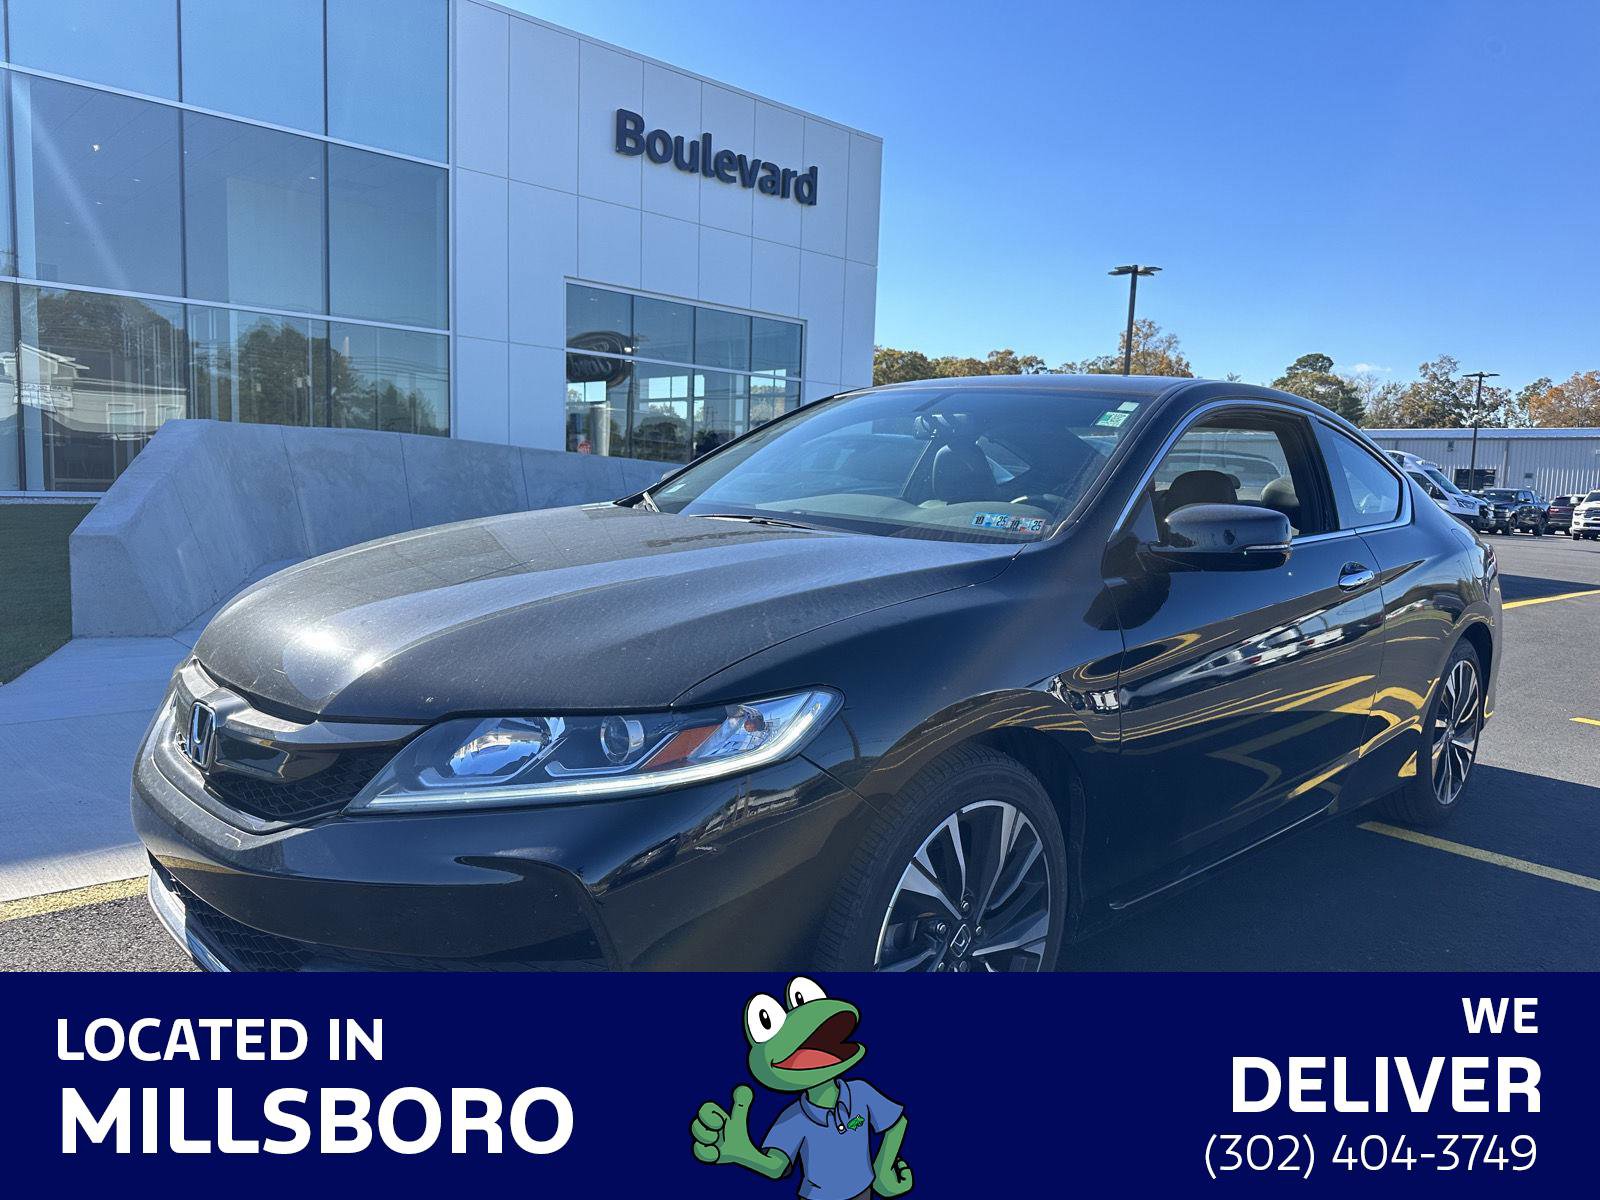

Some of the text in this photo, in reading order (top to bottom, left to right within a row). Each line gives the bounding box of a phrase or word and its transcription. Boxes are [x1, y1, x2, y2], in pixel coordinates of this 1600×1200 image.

[615, 108, 818, 206] Boulevard
[996, 515, 1008, 526] 25
[1030, 520, 1043, 531] 25
